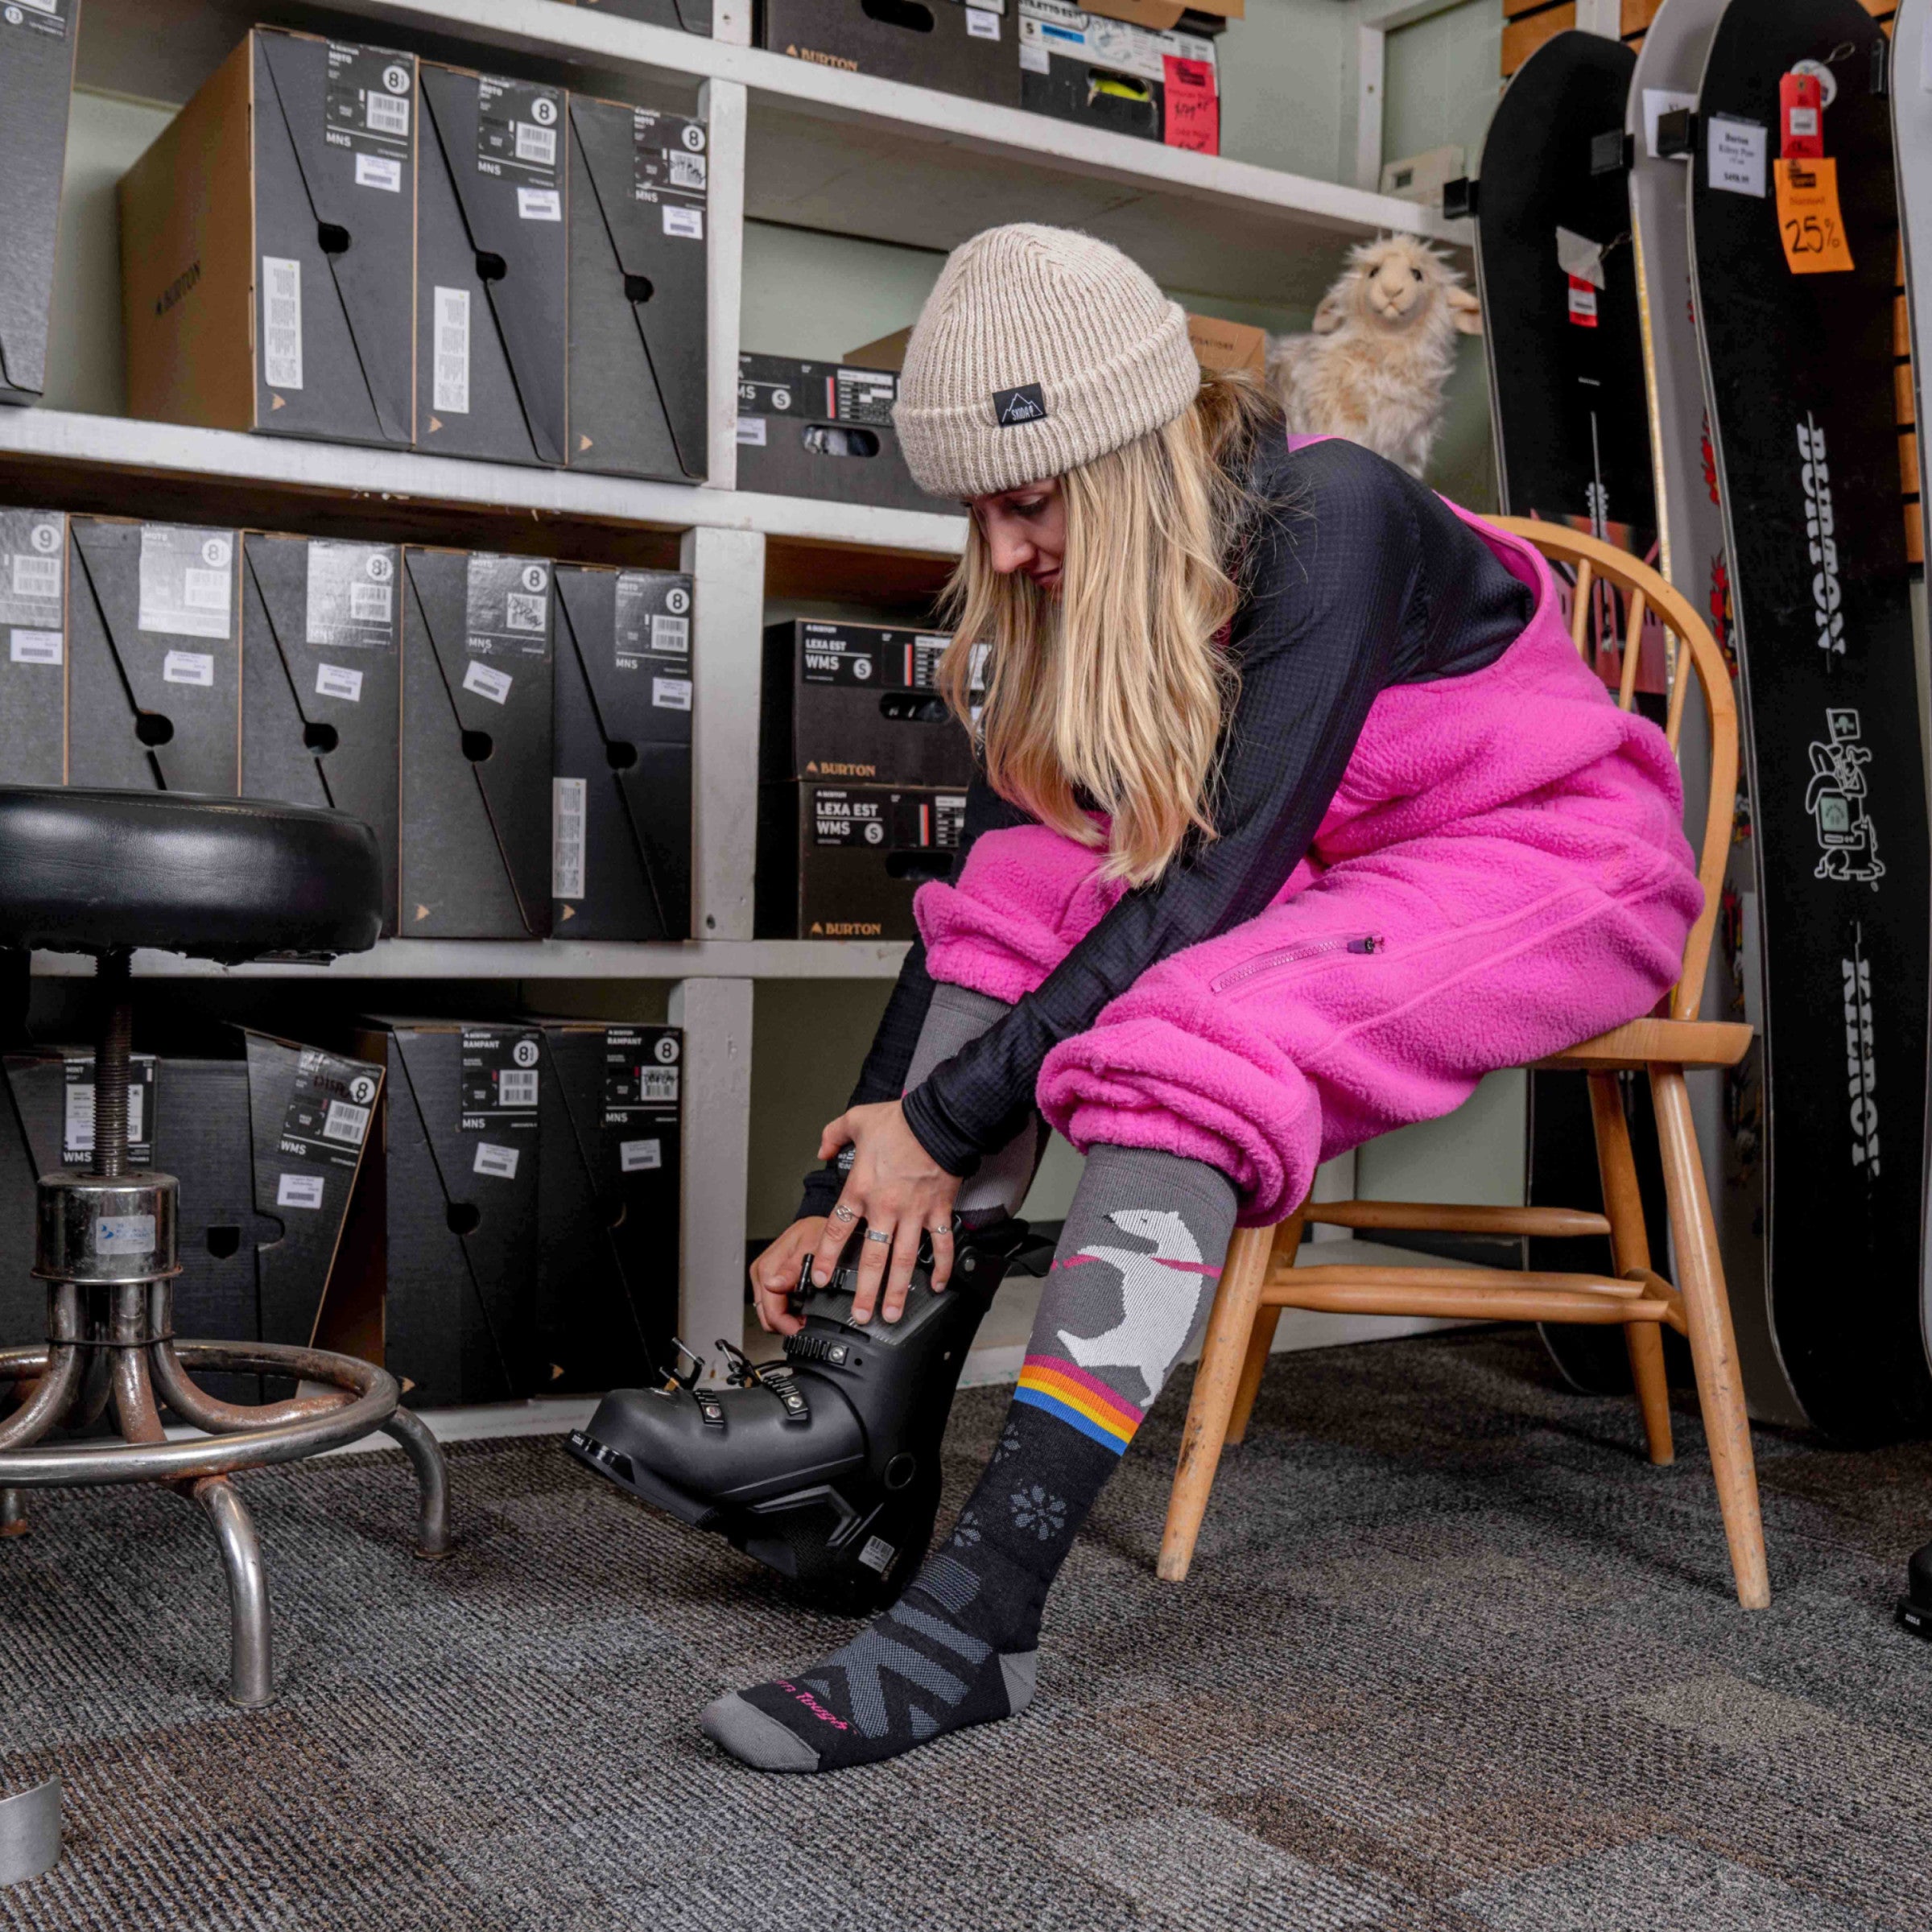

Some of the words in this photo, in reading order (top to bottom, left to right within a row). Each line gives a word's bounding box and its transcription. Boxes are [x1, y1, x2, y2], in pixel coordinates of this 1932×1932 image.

[801, 47, 858, 72] BURTON
[389, 71, 398, 88] 8
[539, 103, 549, 120] 8
[326, 131, 351, 147] MNS
[689, 130, 698, 147] 8
[477, 161, 502, 176] MNS
[635, 190, 658, 203] MNS
[1785, 215, 1840, 254] 25%
[40, 530, 52, 548] 9
[1796, 423, 1846, 654] BURTON
[208, 544, 218, 561] 8
[373, 559, 382, 576] 8
[529, 570, 540, 588] 8
[673, 593, 683, 610] 8
[469, 638, 492, 649] MNS
[806, 638, 828, 650] LEXA
[829, 640, 847, 651] EST
[616, 658, 638, 670] MNS
[806, 654, 839, 671] WMS
[821, 762, 876, 777] BURTON
[816, 802, 851, 815] LEXA
[853, 803, 878, 816] EST
[816, 821, 850, 835] WMS
[826, 923, 881, 935] BURTON
[463, 1040, 500, 1049] RAMPANT
[607, 1037, 642, 1046] RAMPANT
[518, 1046, 528, 1062] 8
[663, 1042, 671, 1059] 8
[1841, 958, 1880, 1176] KILROY
[356, 1081, 369, 1101] 8
[462, 1118, 485, 1129] MNS
[606, 1113, 628, 1123] MNS
[281, 1140, 307, 1156] WMS
[64, 1151, 93, 1163] WMS
